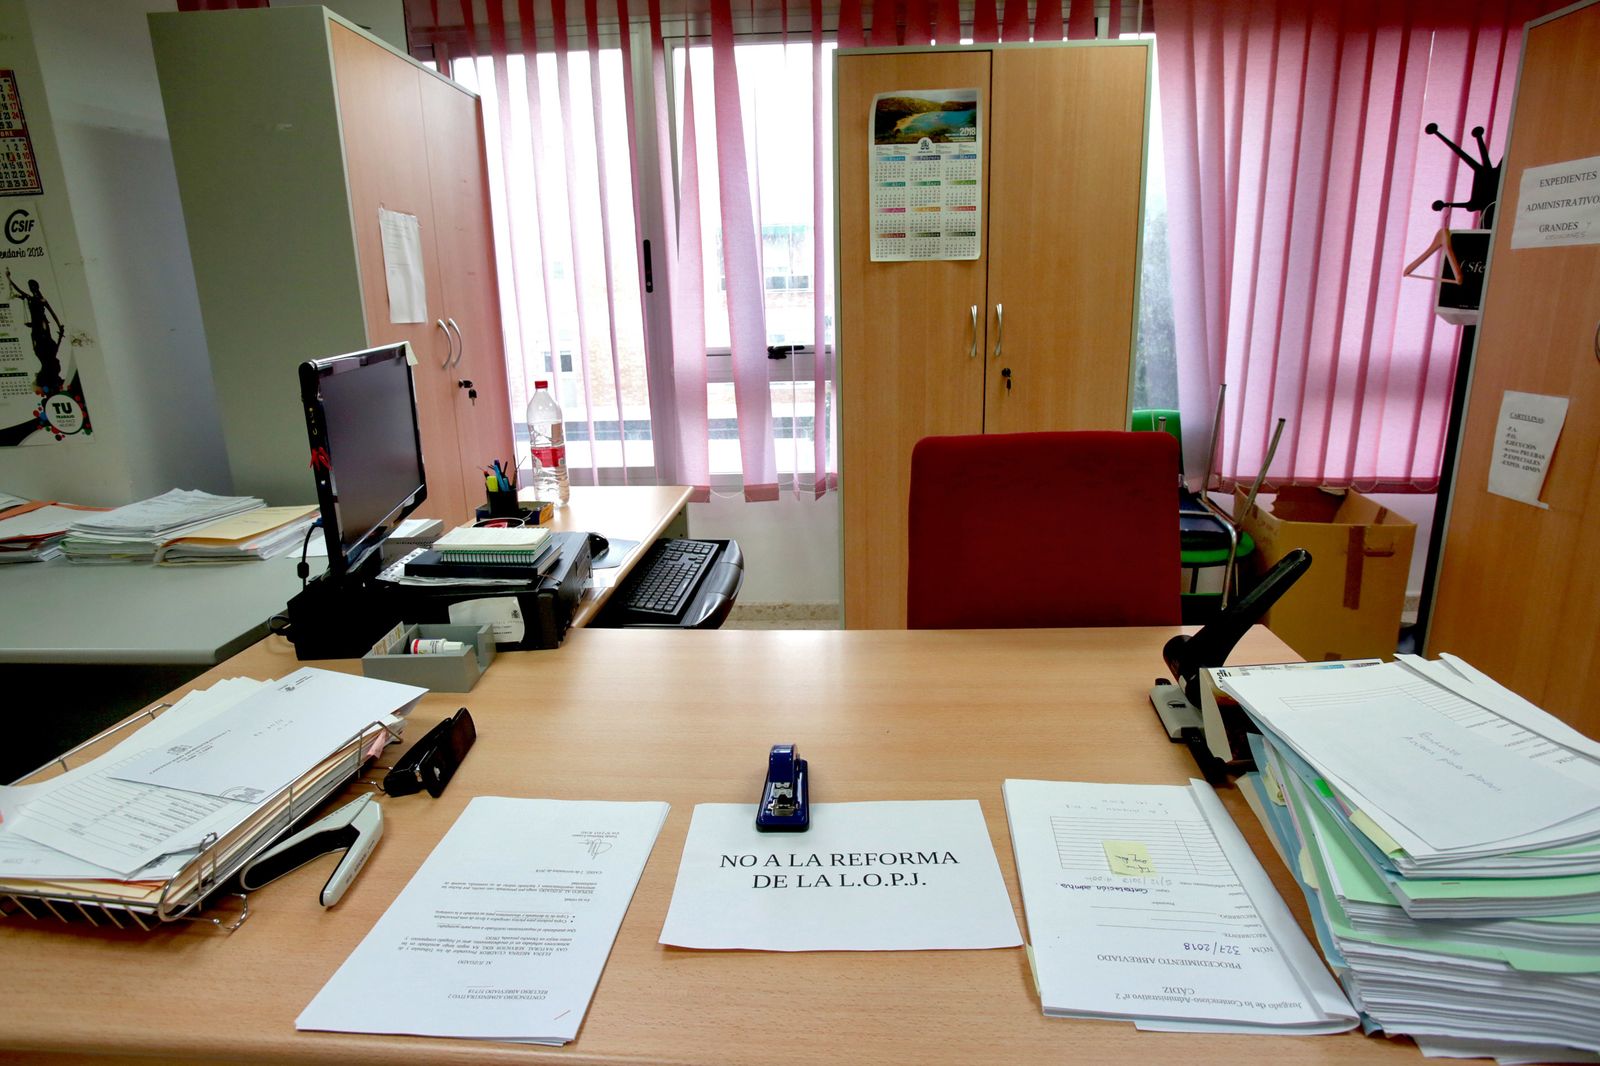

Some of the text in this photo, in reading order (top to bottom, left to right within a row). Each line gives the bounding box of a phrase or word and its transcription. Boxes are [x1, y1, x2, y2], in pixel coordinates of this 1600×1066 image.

[1539, 171, 1597, 187] EXPEDIENTES
[1539, 222, 1578, 233] GRANDES
[27, 246, 44, 257] 2018
[52, 402, 72, 414] TU
[719, 851, 960, 869] NO A LA REFORMA
[751, 872, 927, 889] DE LA L.O.P.J.
[1096, 884, 1149, 895] Contratación
[1096, 953, 1241, 970] PROCEDIMIENTO ABREVIADO
[1114, 992, 1120, 1000] 2
[1162, 986, 1195, 996] CÁDIZ
[1133, 993, 1243, 1008] Contencioso-Administrativo
[1244, 1000, 1253, 1009] lo
[1255, 1001, 1266, 1010] de
[1268, 1001, 1302, 1011] Juzgado
